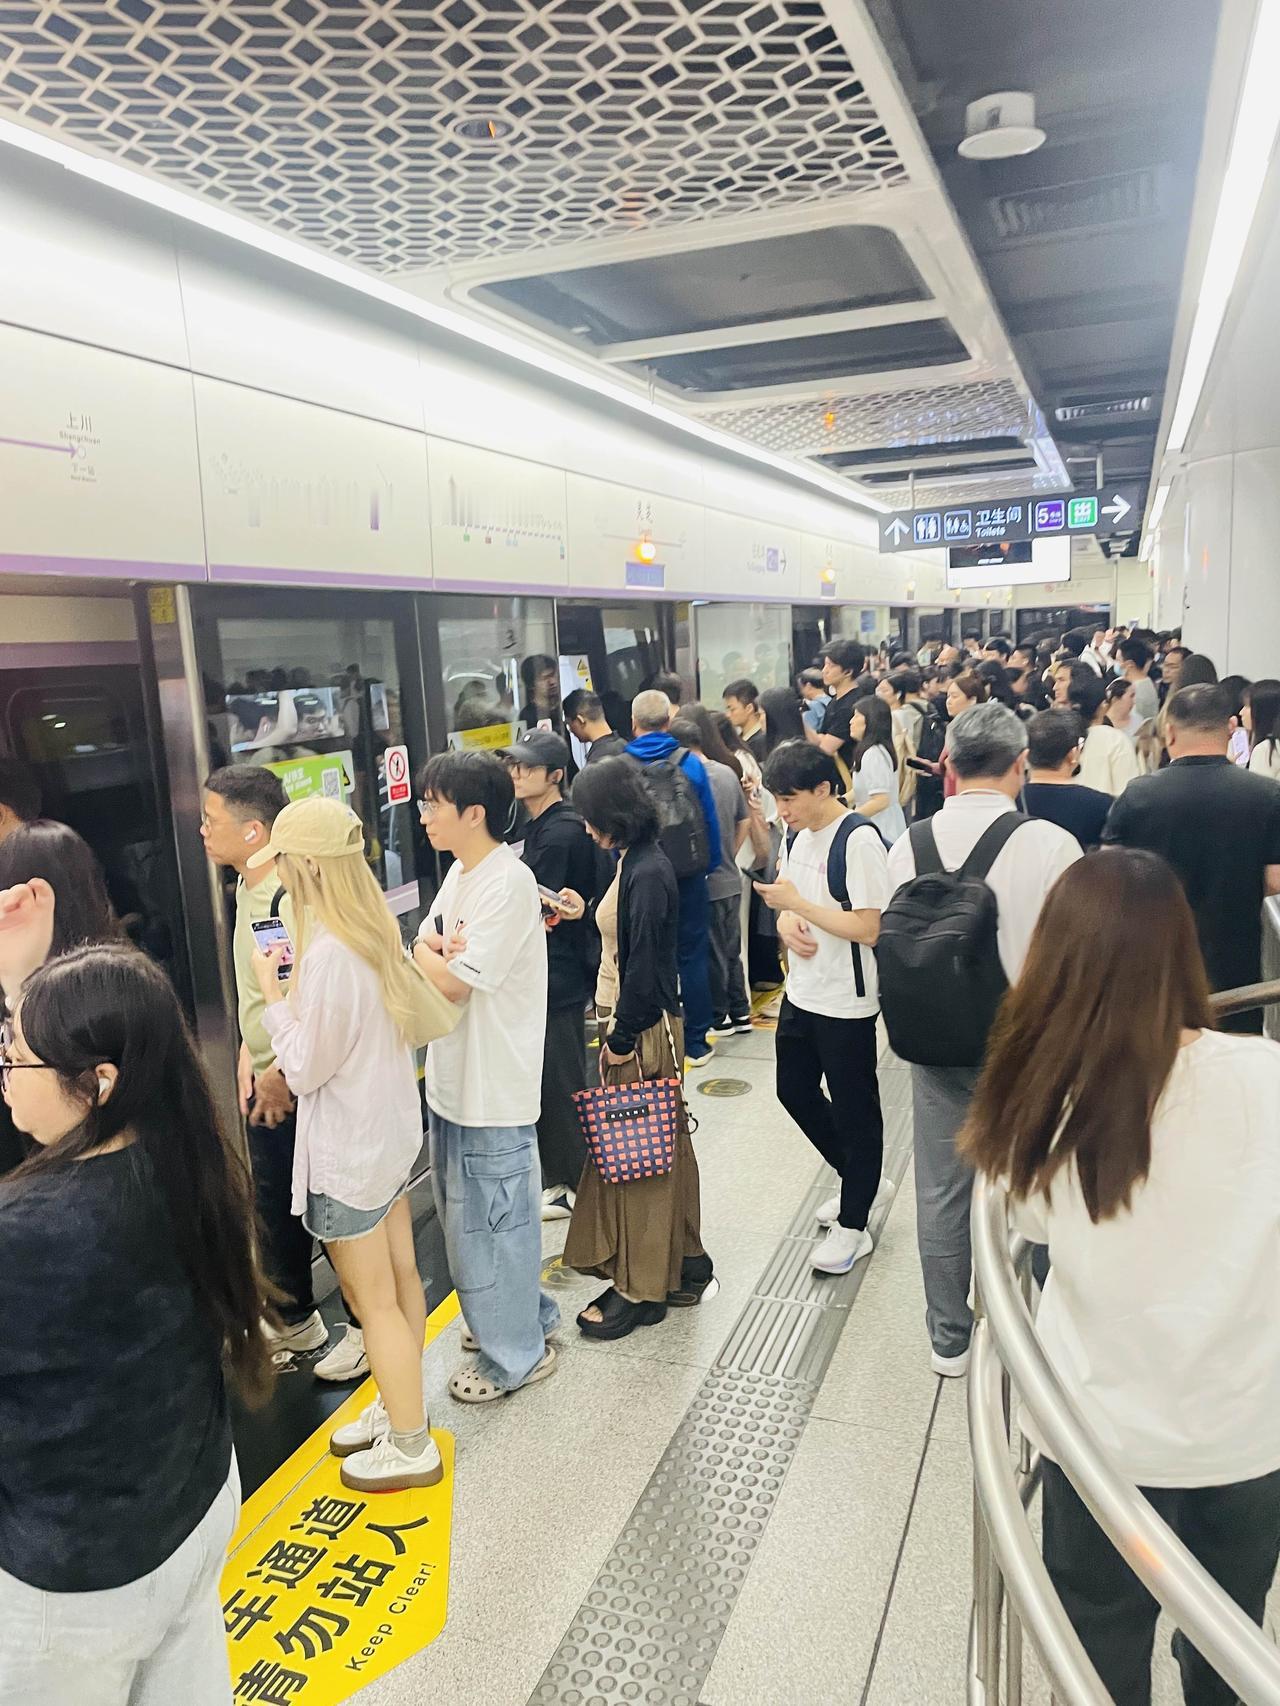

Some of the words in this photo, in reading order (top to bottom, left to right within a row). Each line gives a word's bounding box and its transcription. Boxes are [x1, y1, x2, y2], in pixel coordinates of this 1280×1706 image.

[66, 411, 92, 433] 上川
[975, 506, 1022, 527] 卫生间
[975, 526, 1006, 538] Toilets
[345, 1622, 393, 1671] Keep
[388, 1562, 436, 1615] Clear!
